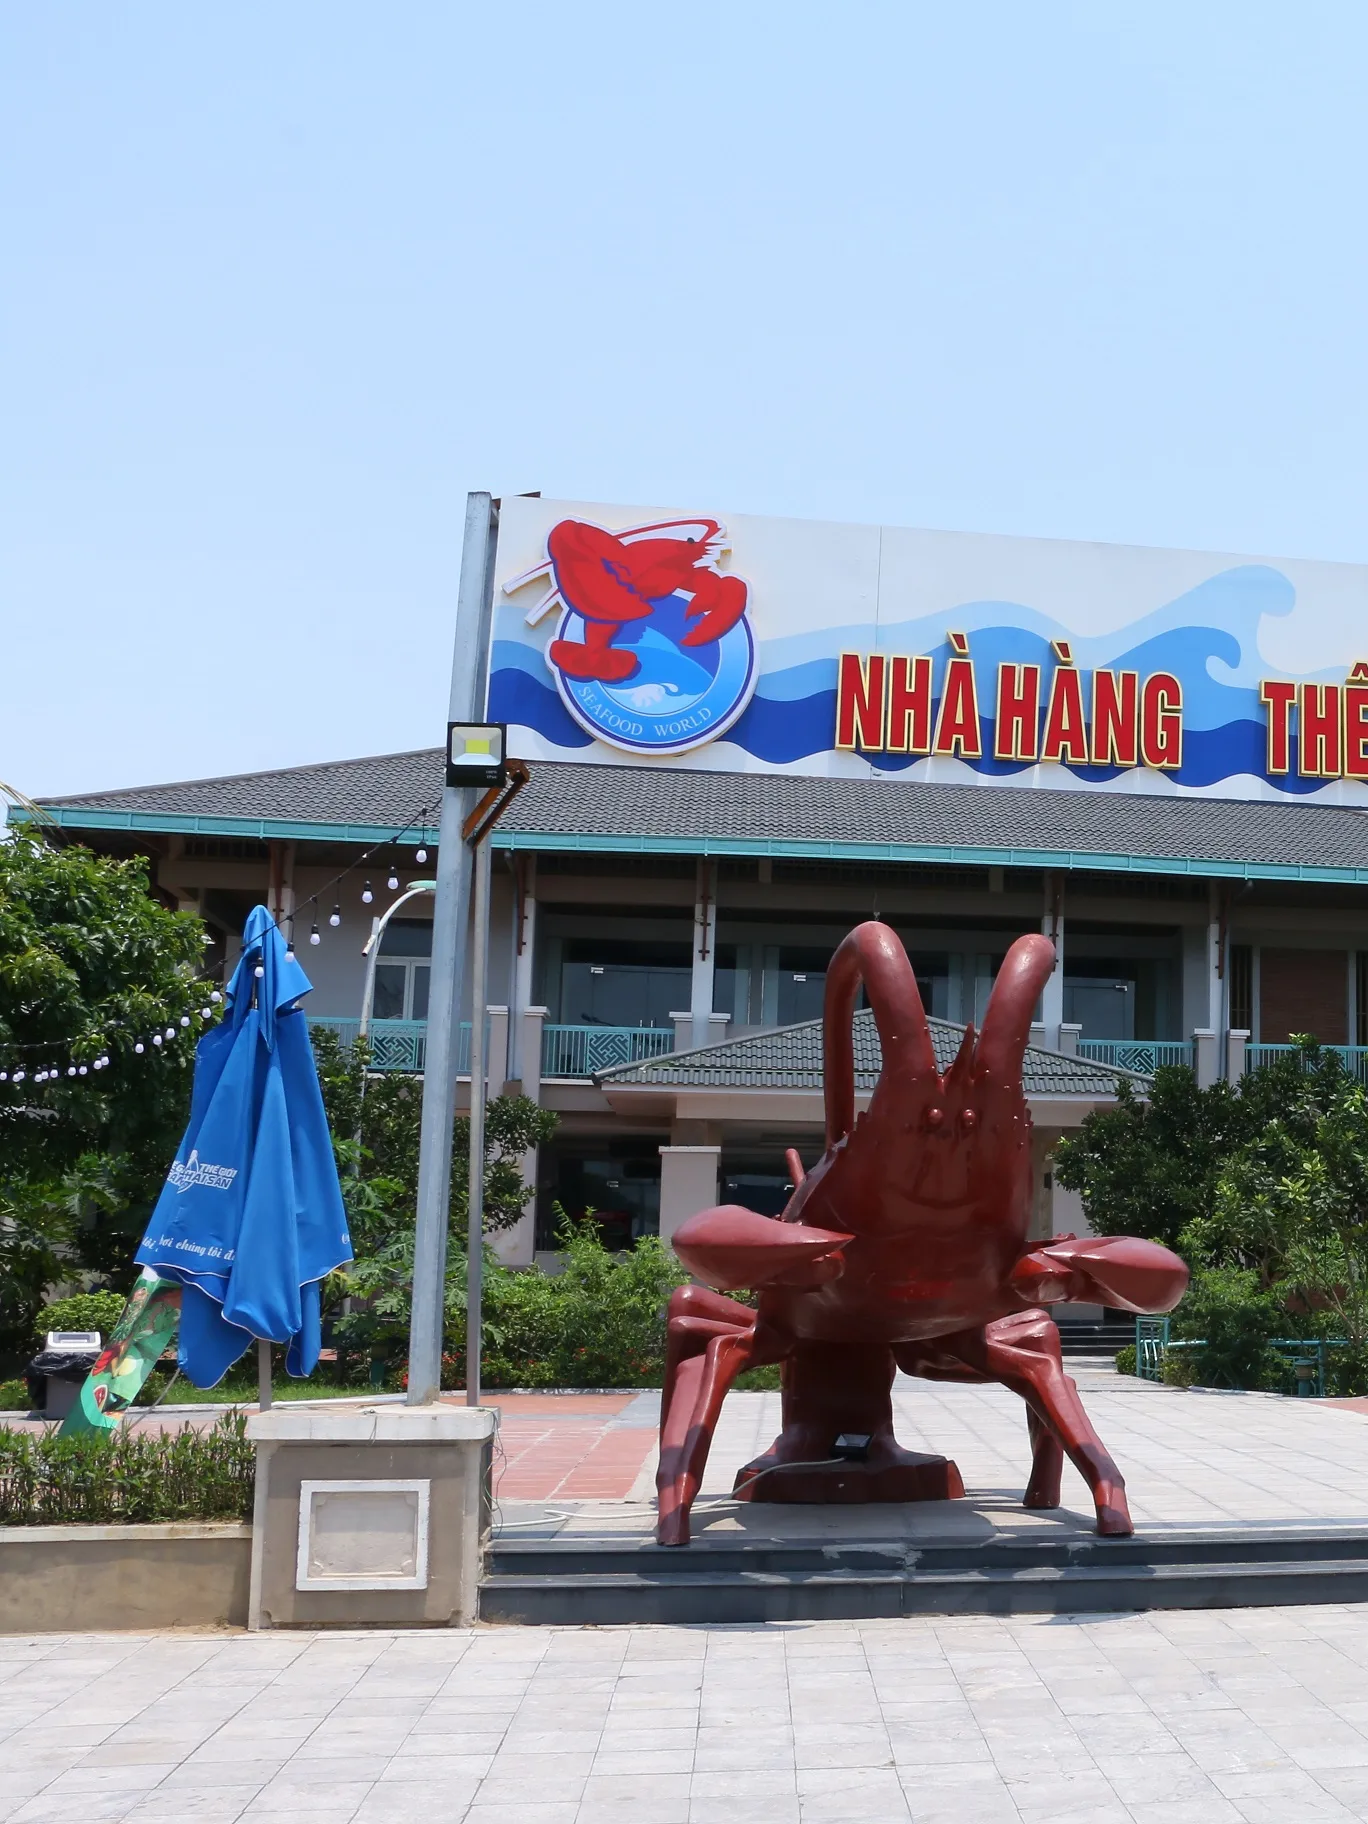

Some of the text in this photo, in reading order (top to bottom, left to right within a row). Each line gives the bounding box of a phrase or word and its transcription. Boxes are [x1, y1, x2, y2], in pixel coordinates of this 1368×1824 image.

[578, 686, 712, 736] SEAFOOD WORLD
[835, 631, 982, 759] NHÀ
[994, 640, 1183, 770] HÀNG
